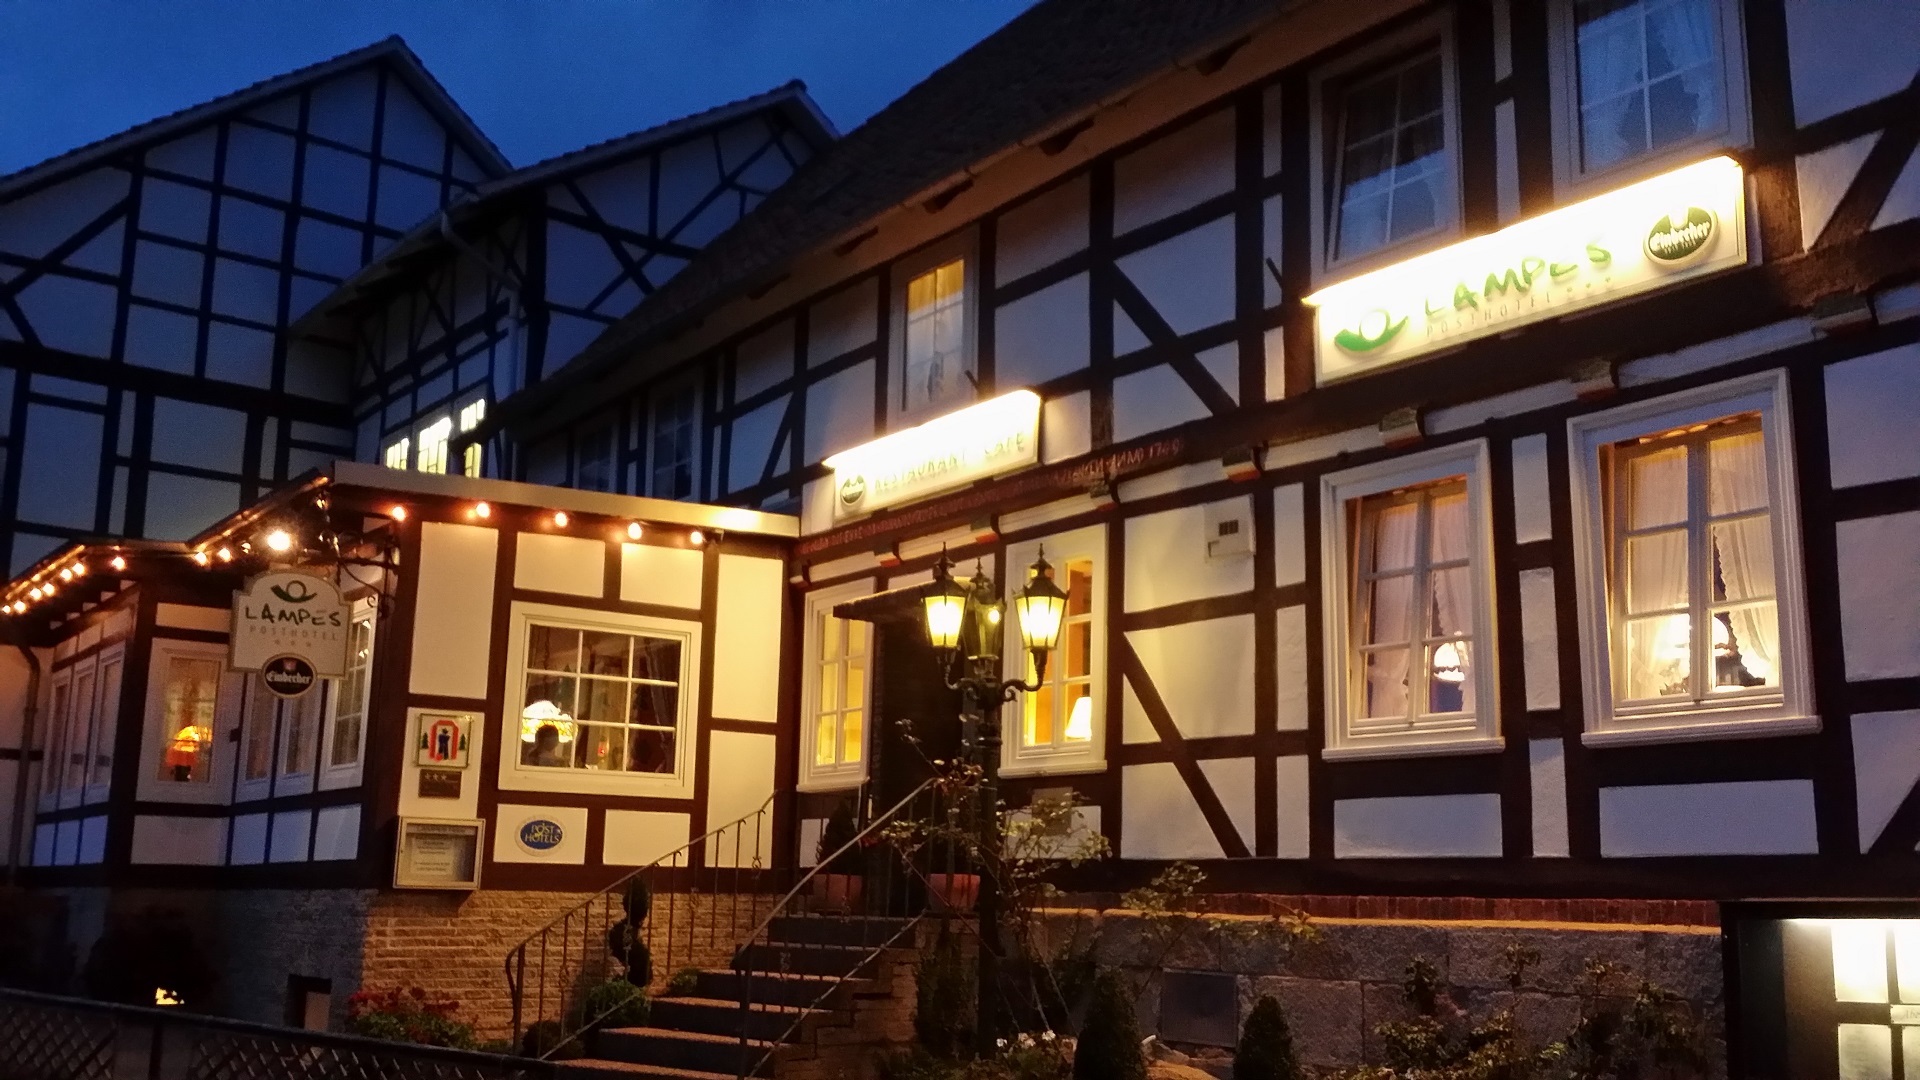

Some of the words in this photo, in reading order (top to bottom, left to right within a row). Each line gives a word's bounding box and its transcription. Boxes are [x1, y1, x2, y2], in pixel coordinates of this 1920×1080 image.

[1424, 236, 1612, 317] LAMPES
[245, 603, 341, 626] LAMPES
[250, 625, 337, 641] POSTHOTEL
[531, 823, 555, 834] POST
[525, 833, 560, 843] HOTELS
